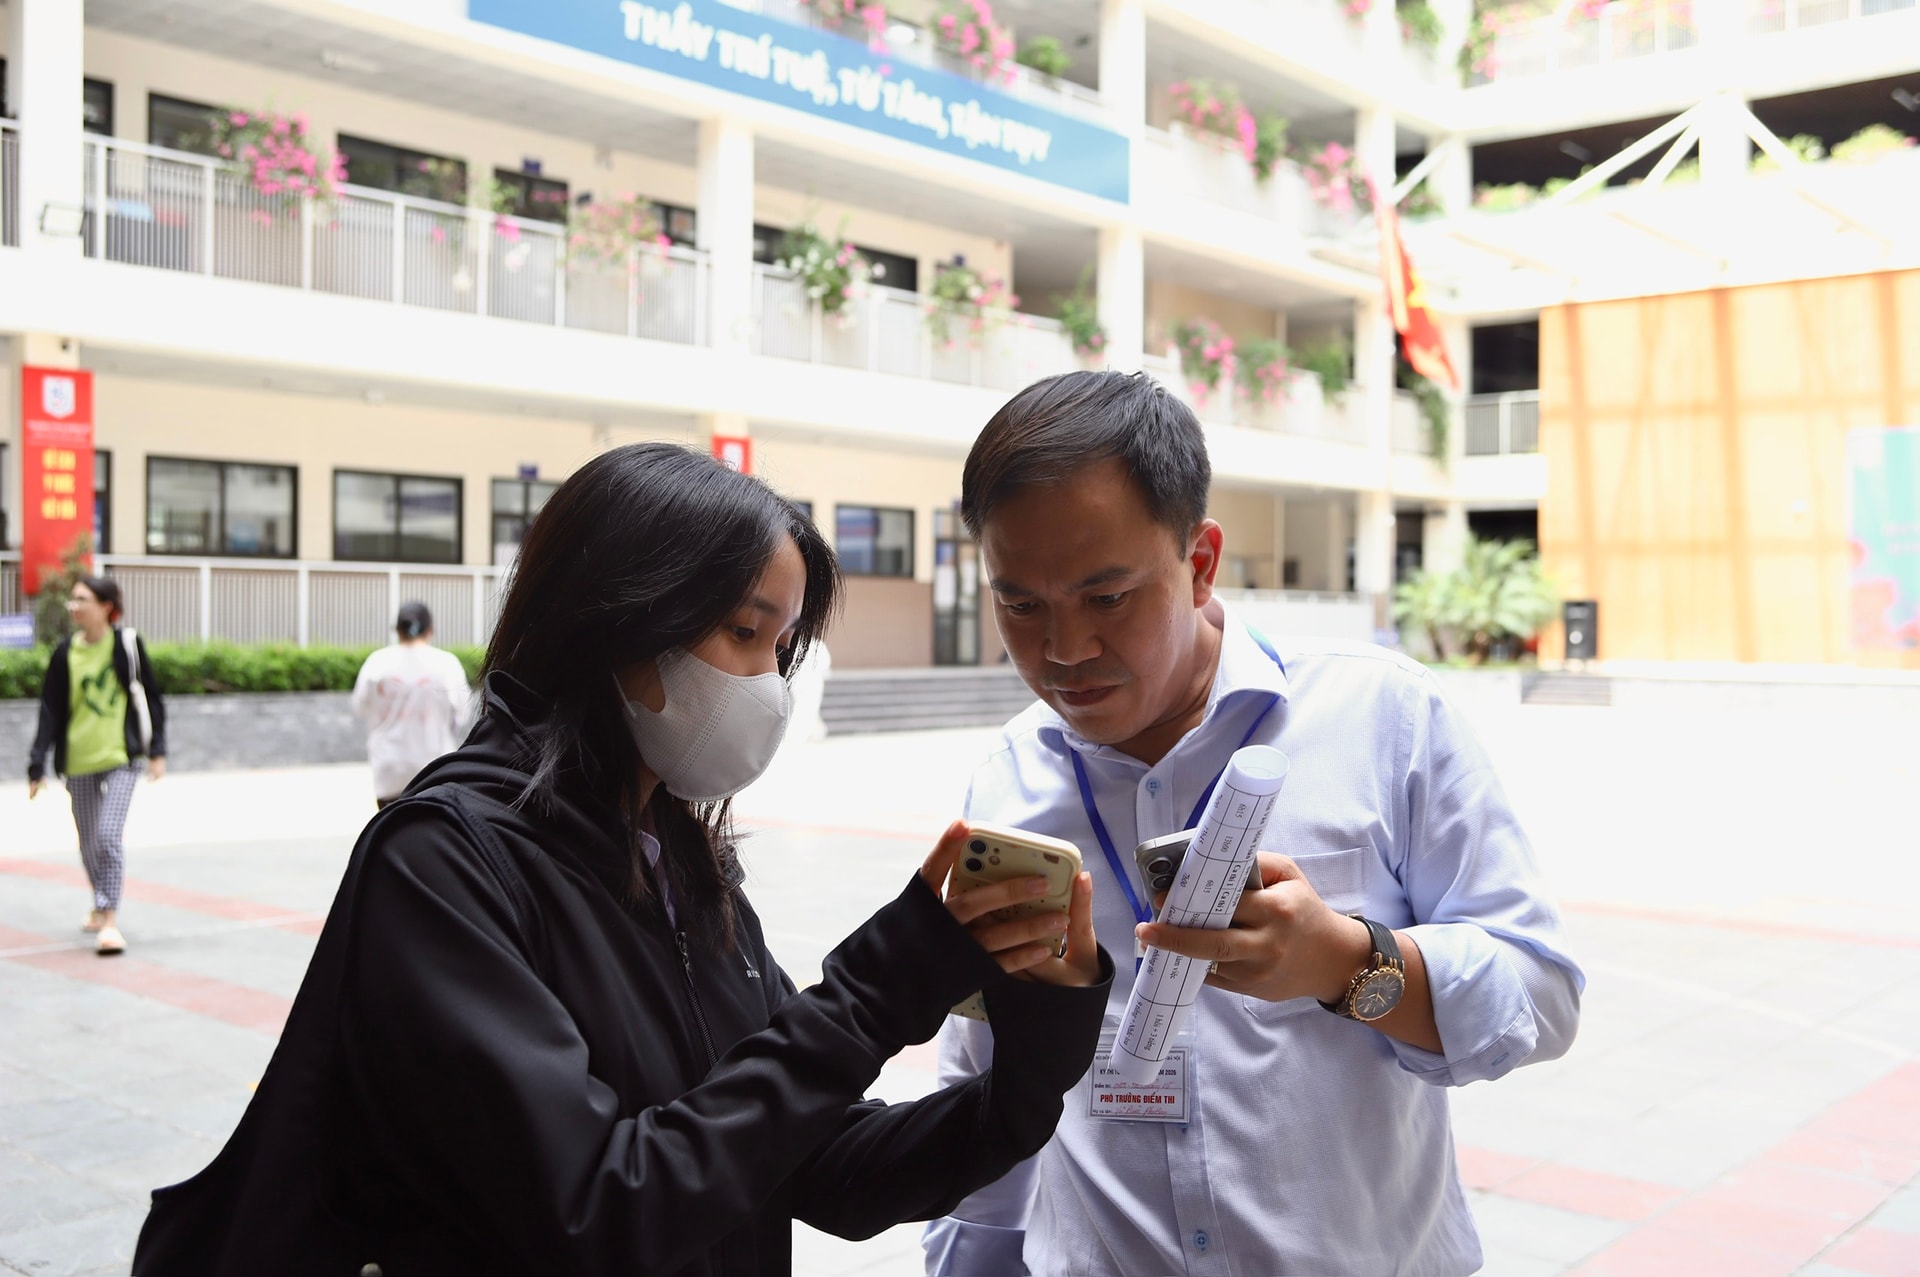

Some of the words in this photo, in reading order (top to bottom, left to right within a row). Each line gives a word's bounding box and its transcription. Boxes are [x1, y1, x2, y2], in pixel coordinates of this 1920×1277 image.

[715, 29, 772, 79] TRÍ
[1236, 803, 1246, 818] 6h15
[1220, 835, 1233, 852] 13h00
[1231, 864, 1241, 873] Ca
[1180, 872, 1190, 887] 7h00
[1228, 873, 1237, 882] thi
[1204, 879, 1213, 893] 6h15
[1220, 891, 1230, 900] Ca
[1217, 900, 1226, 908] thi
[1164, 1096, 1175, 1104] THI
